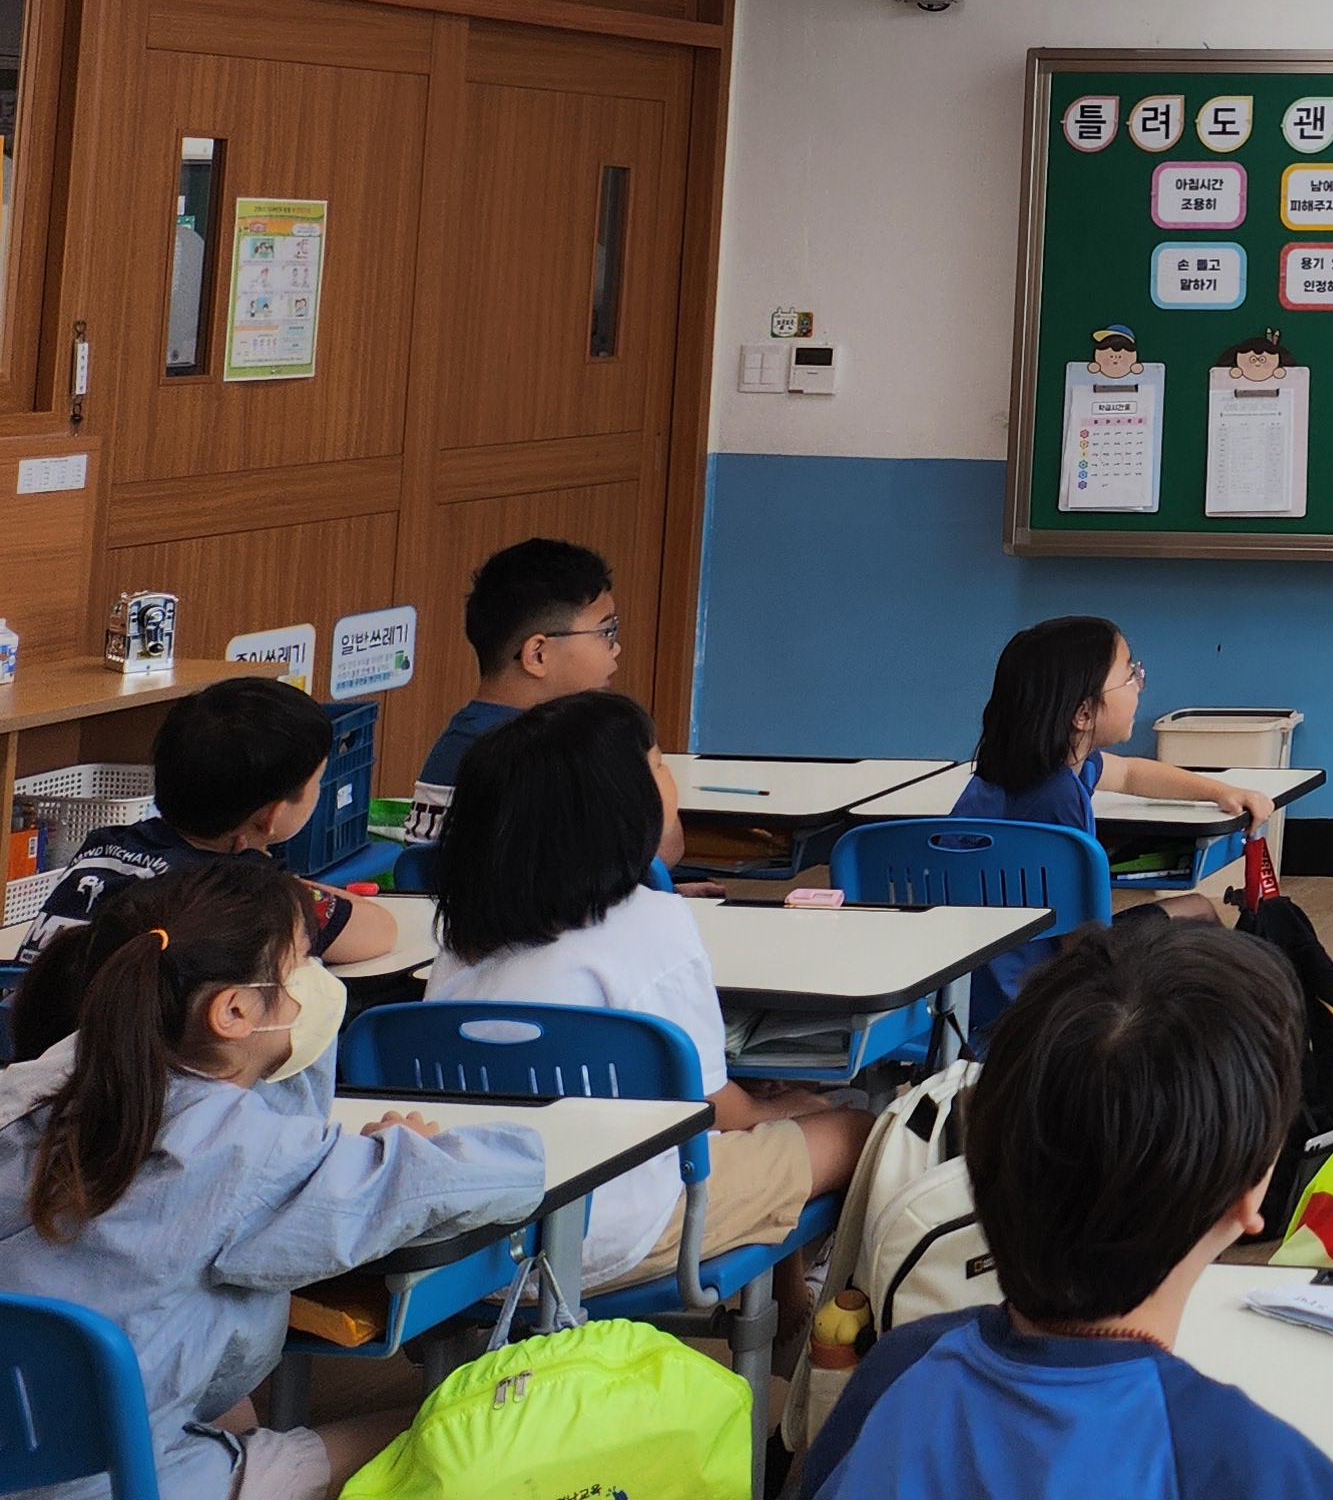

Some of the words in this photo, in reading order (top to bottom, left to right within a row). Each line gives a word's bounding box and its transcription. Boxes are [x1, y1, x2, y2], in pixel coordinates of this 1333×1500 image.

[1073, 103, 1241, 142] 틀려도
[1175, 177, 1224, 192] 아침시간
[1180, 197, 1217, 212] 조용히
[1177, 258, 1190, 272] 손
[1300, 257, 1325, 271] 용기
[1180, 277, 1218, 292] 말하기
[341, 623, 409, 656] 일반쓰레기
